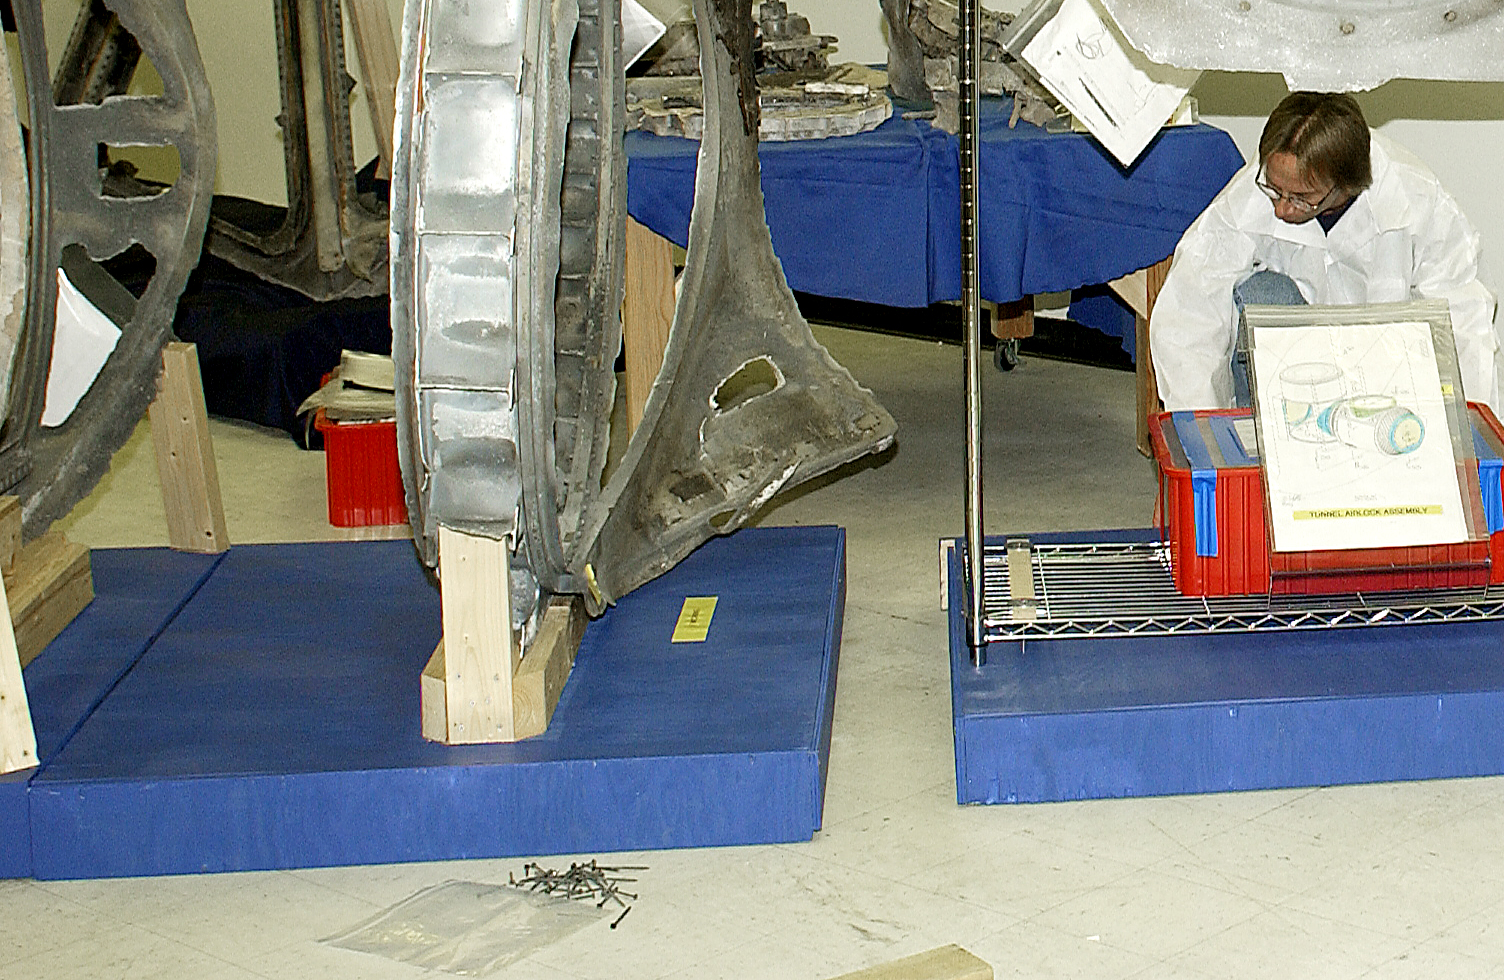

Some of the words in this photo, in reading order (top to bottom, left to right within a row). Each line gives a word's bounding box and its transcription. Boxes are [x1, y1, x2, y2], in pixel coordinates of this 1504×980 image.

[1309, 510, 1343, 519] TUNNEL
[1345, 509, 1381, 518] AIRLOCK
[1383, 506, 1429, 516] ASSEMBLY
